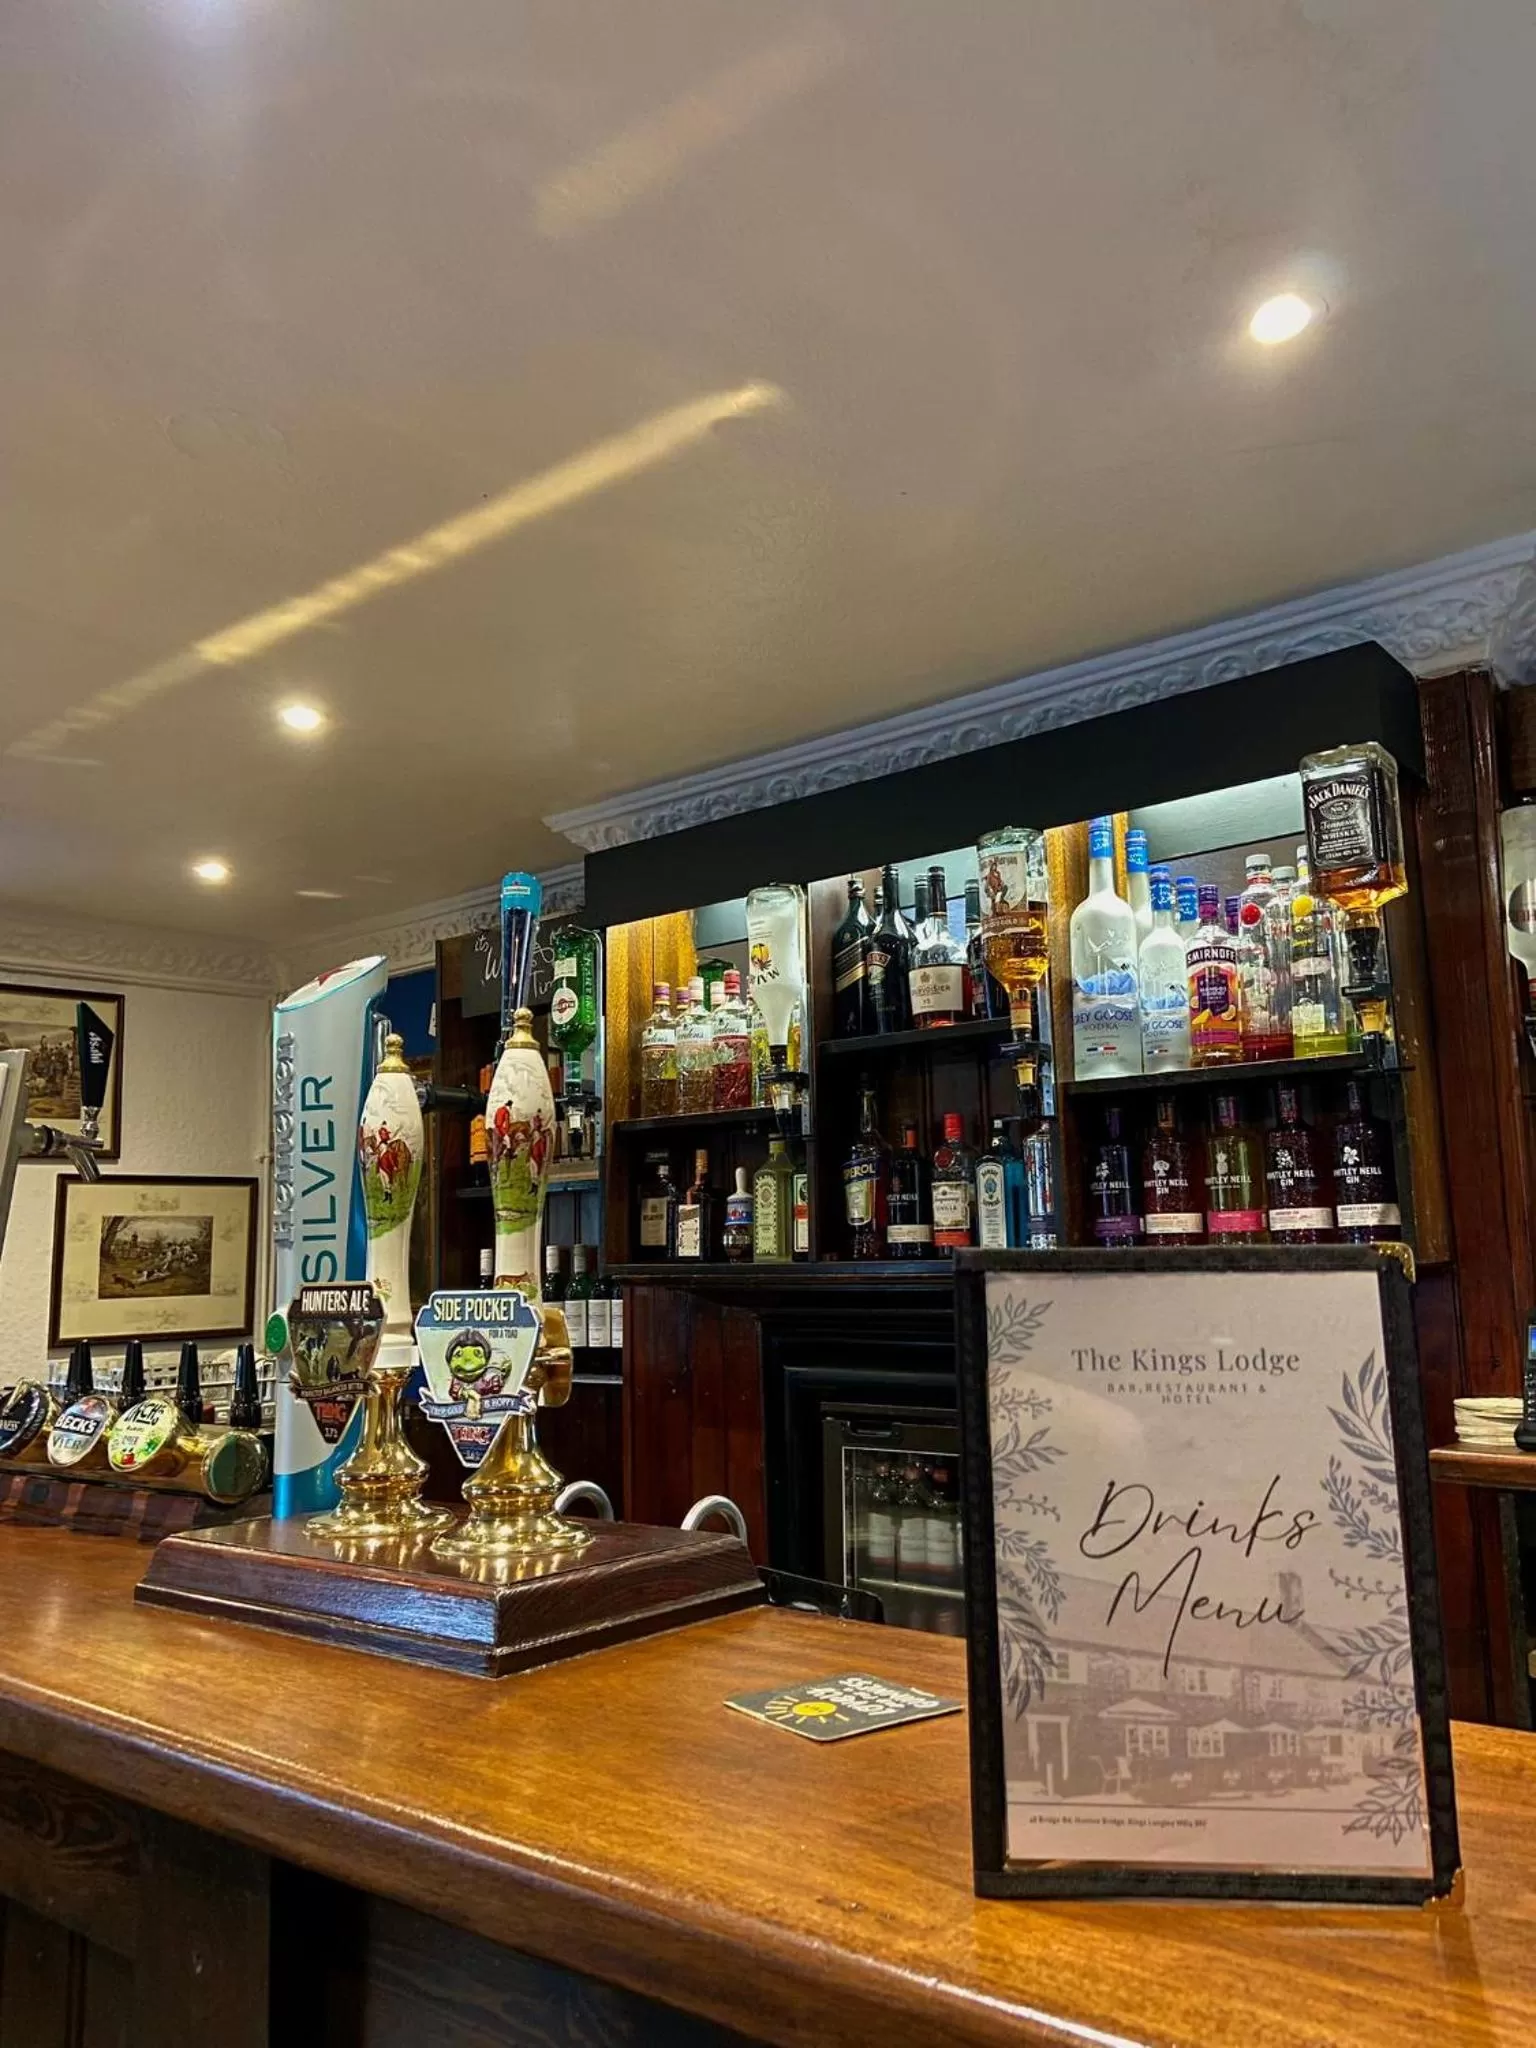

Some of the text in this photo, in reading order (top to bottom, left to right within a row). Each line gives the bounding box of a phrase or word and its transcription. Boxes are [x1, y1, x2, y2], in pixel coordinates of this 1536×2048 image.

[1308, 788, 1332, 809] JACK
[1332, 783, 1372, 799] DANIEL'S
[1187, 947, 1236, 964] SMIRNOFF
[301, 1076, 337, 1283] SILVER
[302, 1289, 371, 1312] HUNTERS ALE
[433, 1297, 517, 1322] SIDE POCKET
[1071, 1347, 1301, 1376] The Kings Lodge
[1161, 1395, 1212, 1405] HOTEL
[55, 1415, 98, 1434] BECK'S
[1080, 1474, 1322, 1559] Drinks
[1106, 1546, 1305, 1679] Menu
